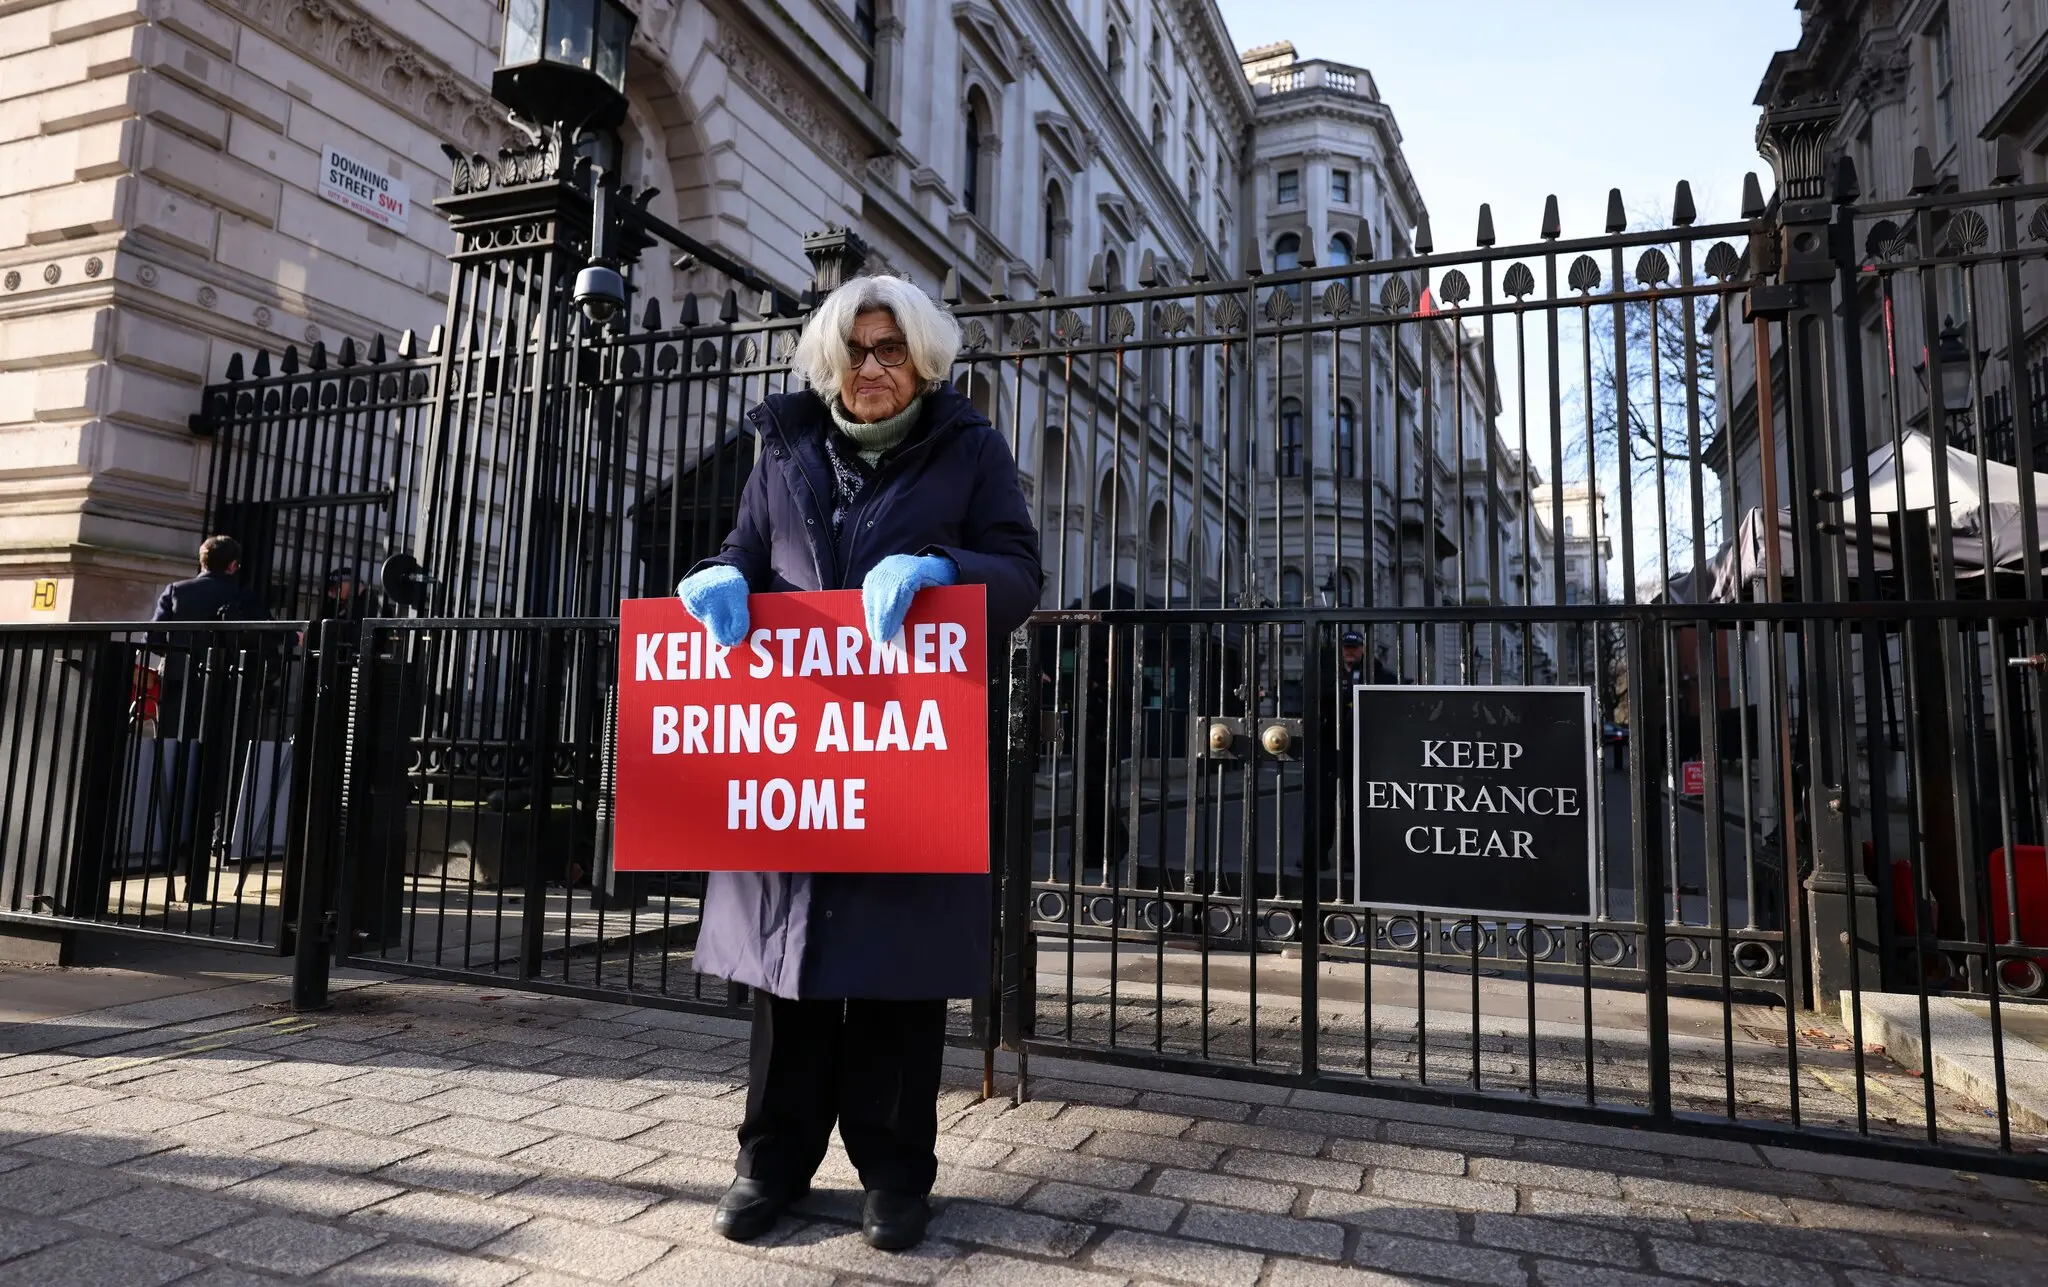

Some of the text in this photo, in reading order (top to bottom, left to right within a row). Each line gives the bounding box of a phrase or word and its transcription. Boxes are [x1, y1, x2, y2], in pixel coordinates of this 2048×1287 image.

[330, 169, 403, 215] STREET SW1
[331, 152, 389, 192] DOWNING
[635, 622, 968, 681] KEIR STARMER
[652, 699, 948, 754] BRING ALAA
[1420, 740, 1523, 769] KEEP
[727, 778, 866, 831] HOME
[1366, 781, 1580, 816] ENTRANCE
[1405, 826, 1539, 859] CLEAR
